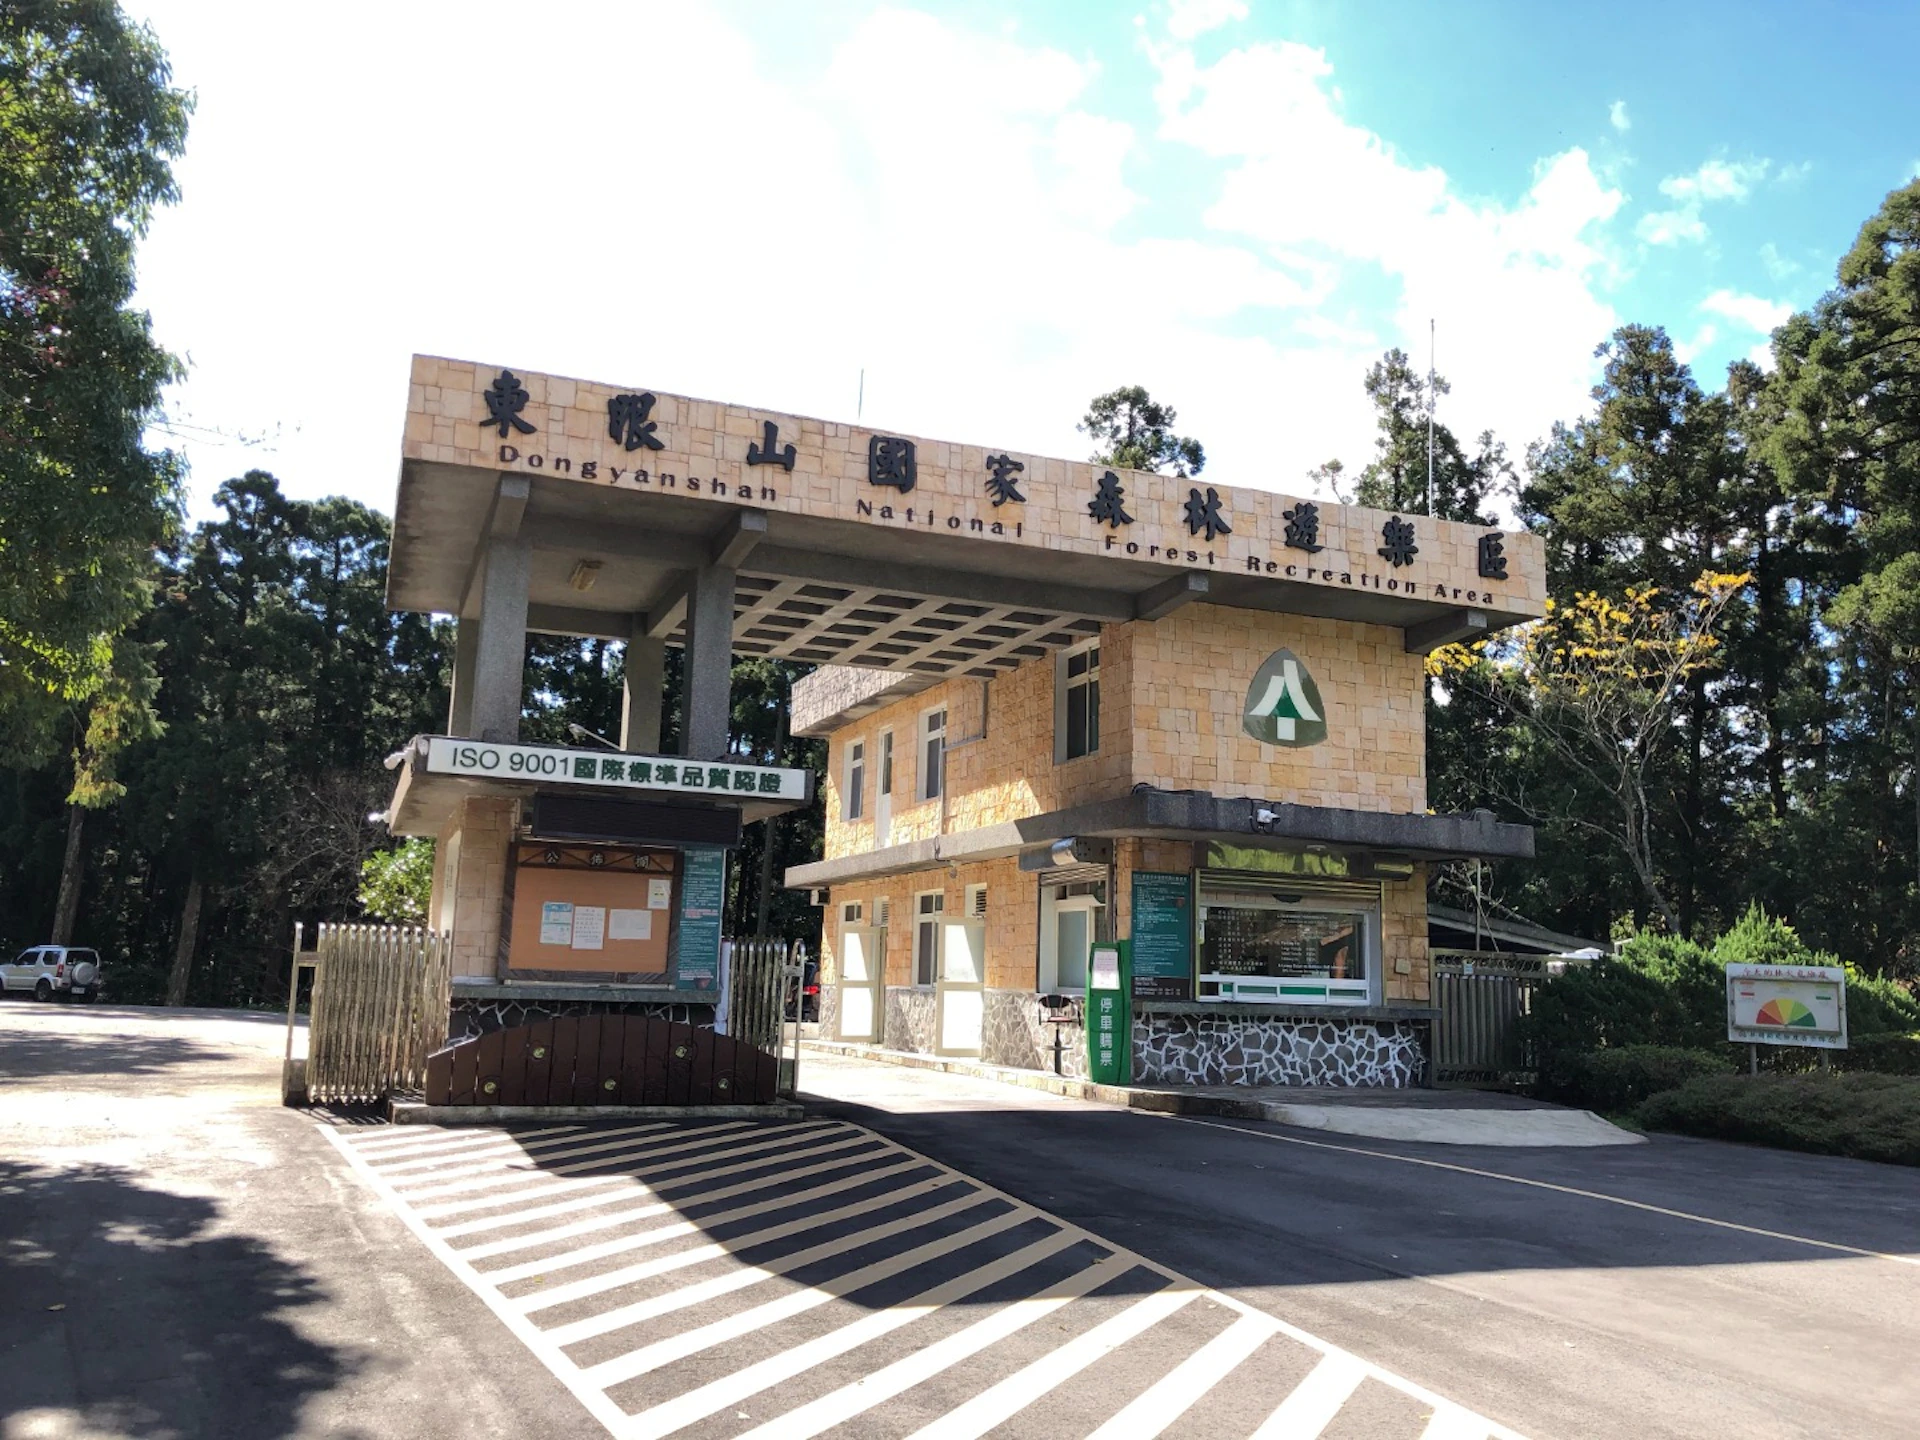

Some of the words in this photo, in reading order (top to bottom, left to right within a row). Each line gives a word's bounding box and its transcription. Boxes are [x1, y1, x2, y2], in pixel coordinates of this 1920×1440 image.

[480, 370, 1509, 580] 東眼山國家森林遊樂區
[499, 445, 778, 502] Dongyanshan
[857, 499, 1023, 538] National
[1105, 534, 1216, 565] Forest
[1247, 555, 1417, 594] Recreation
[1434, 584, 1495, 605] Area
[452, 747, 500, 770] ISO
